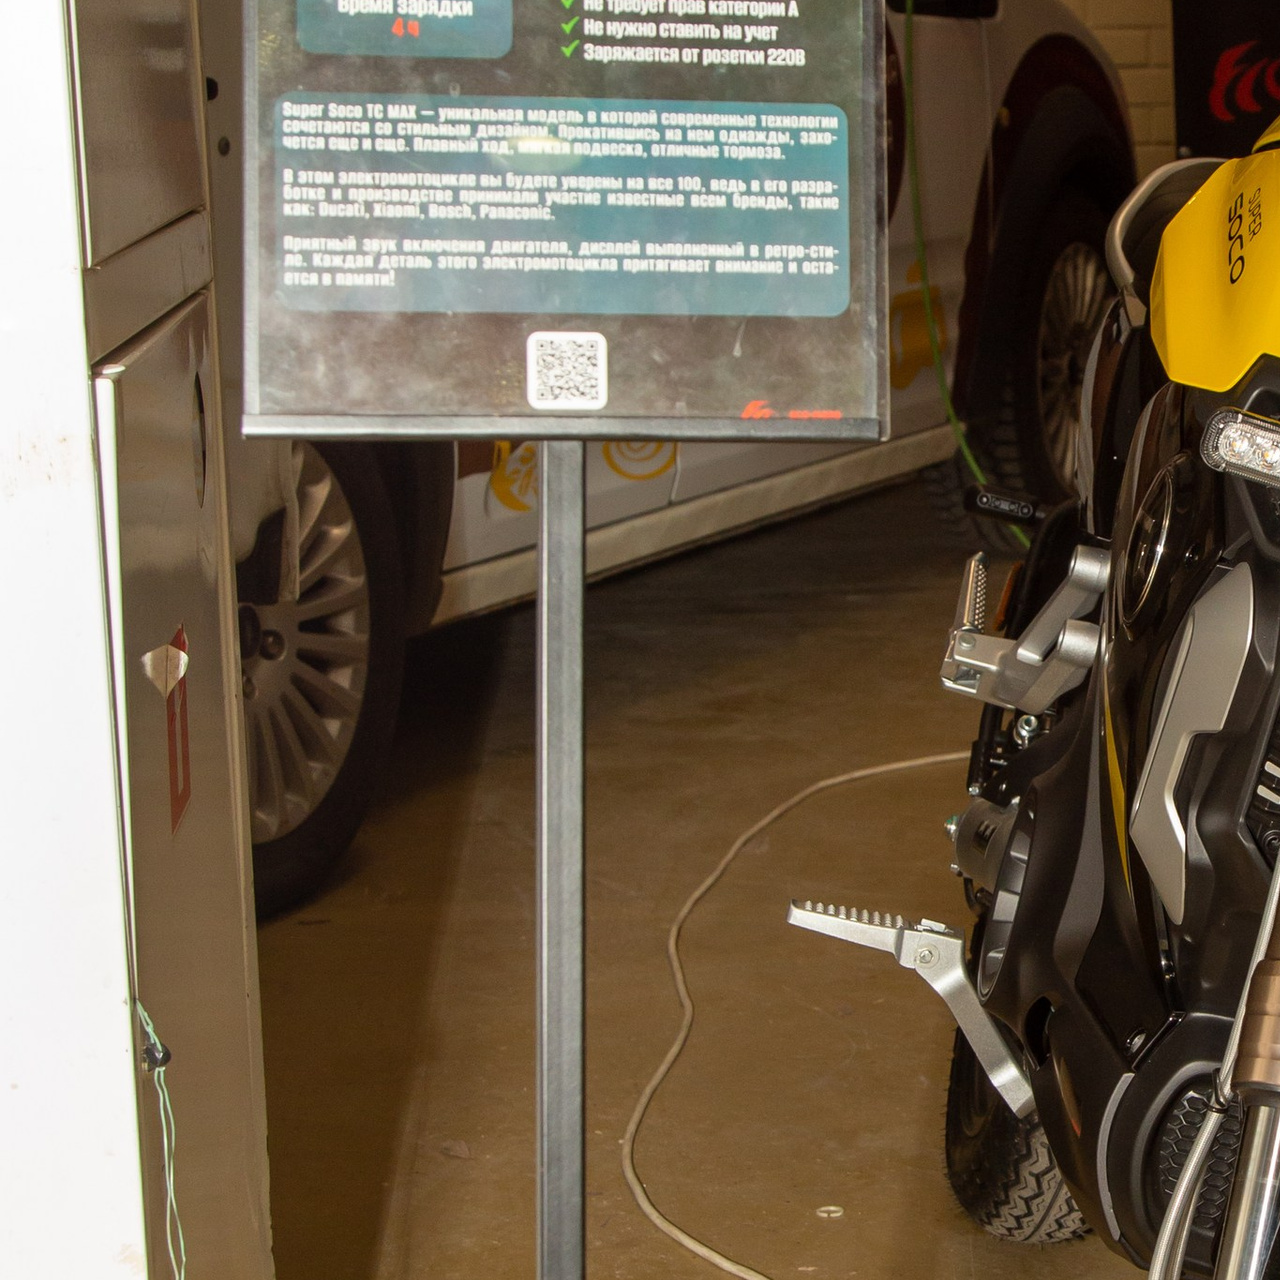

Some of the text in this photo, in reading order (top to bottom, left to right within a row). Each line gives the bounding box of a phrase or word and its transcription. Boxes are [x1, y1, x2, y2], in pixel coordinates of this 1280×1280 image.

[708, 0, 786, 19] категории
[391, 17, 421, 38] 4 ч
[583, 18, 779, 43] Не нужно ставить на учет
[583, 43, 680, 63] Заряжается
[682, 48, 700, 63] от
[702, 49, 765, 66] розетки
[1247, 187, 1263, 242] SUPER
[1227, 191, 1246, 285] SOCO
